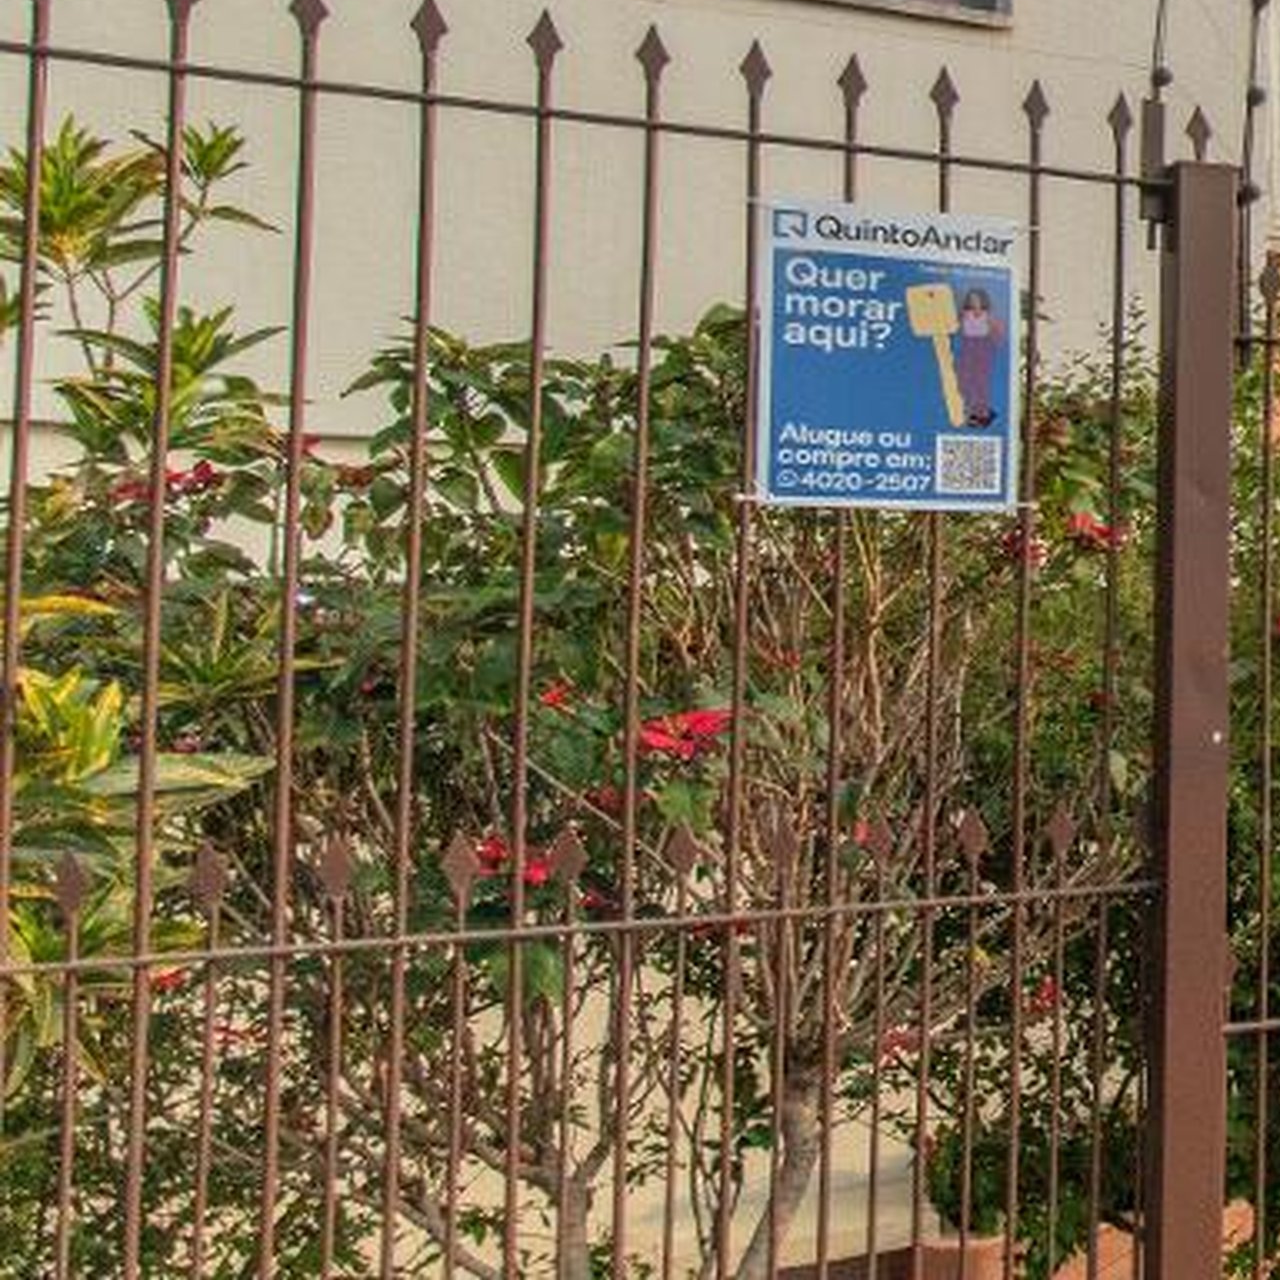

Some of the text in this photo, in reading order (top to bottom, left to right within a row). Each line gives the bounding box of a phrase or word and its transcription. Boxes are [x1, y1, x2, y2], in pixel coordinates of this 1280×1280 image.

[815, 214, 1012, 255] QuintoAndar
[786, 257, 885, 291] Quer
[784, 292, 902, 321] morar
[783, 321, 892, 353] aqui?
[779, 422, 911, 448] Alugue ou
[778, 448, 881, 470] compre
[800, 471, 931, 492] 4020-2507
